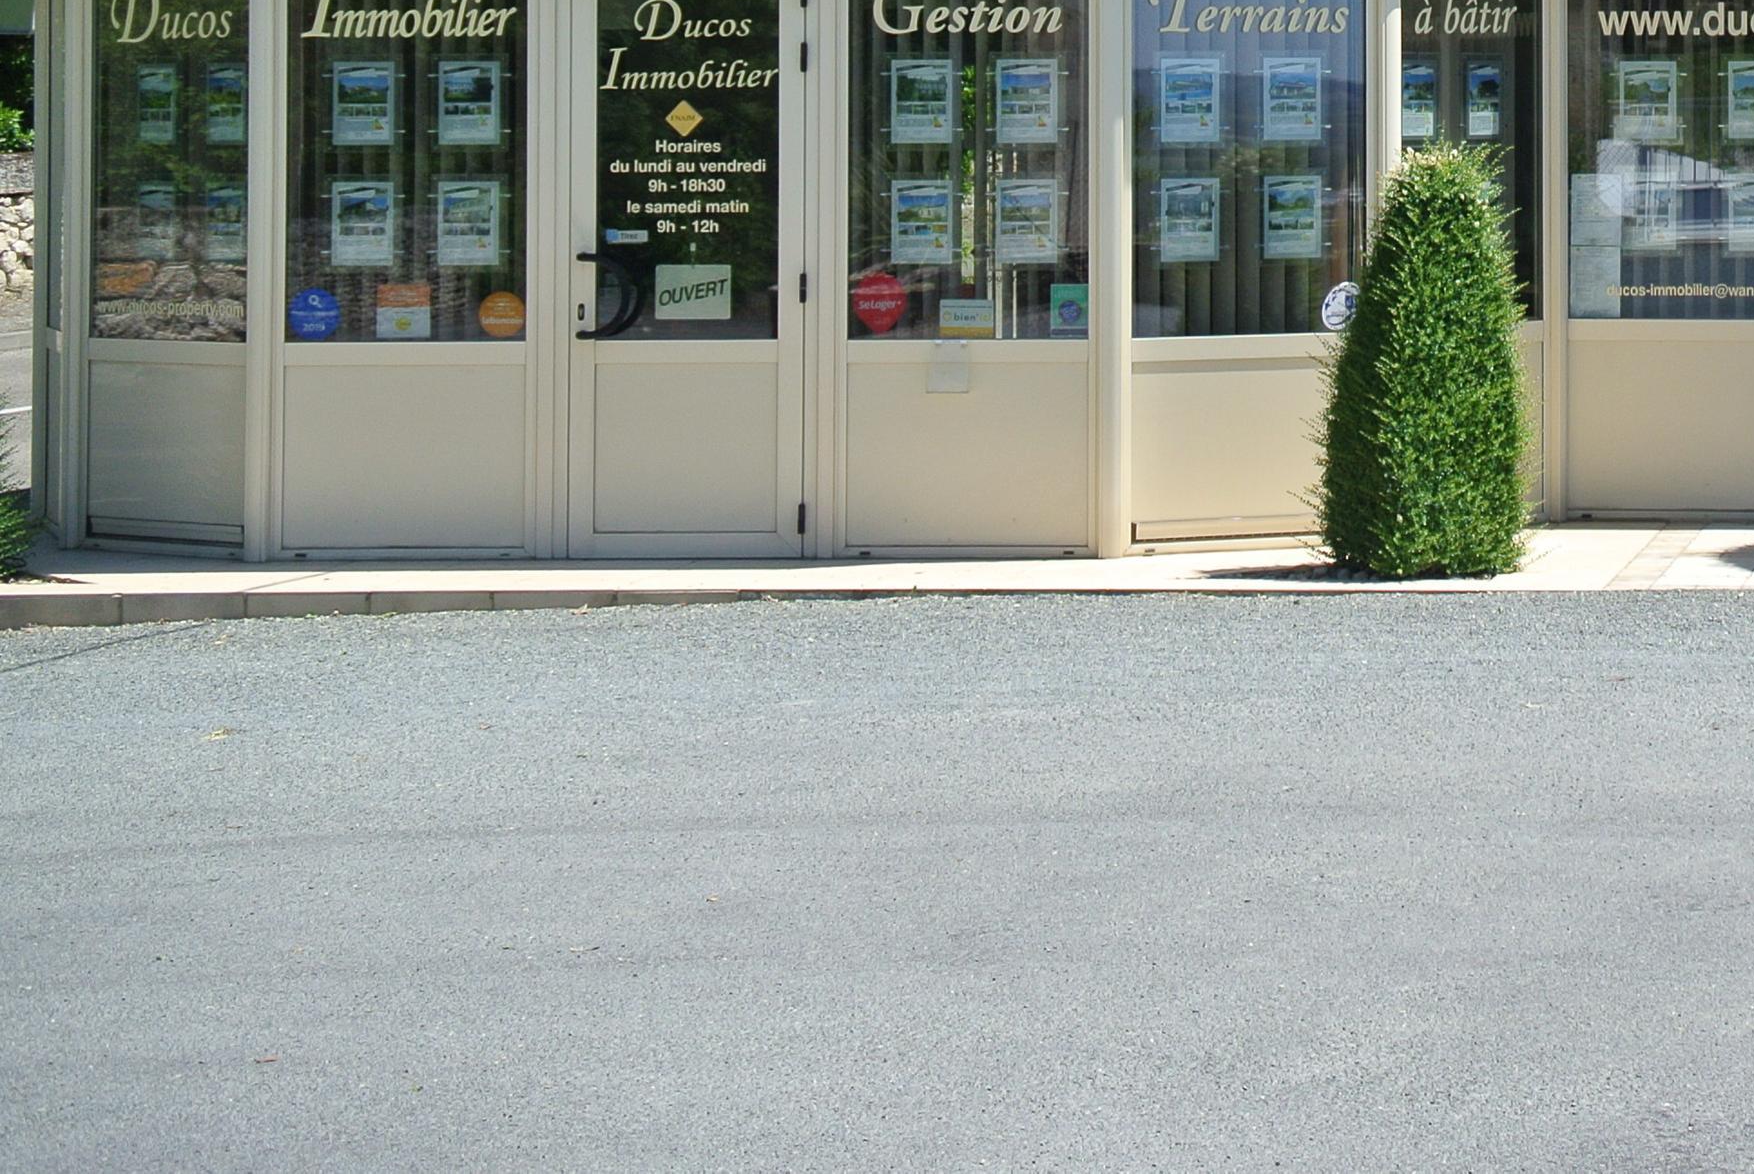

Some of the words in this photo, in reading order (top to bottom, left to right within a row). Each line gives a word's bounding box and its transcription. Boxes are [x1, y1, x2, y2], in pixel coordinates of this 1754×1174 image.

[600, 47, 778, 89] Immobilier
[655, 139, 722, 153] Horaires
[610, 160, 629, 172] du
[634, 160, 671, 172] lundi
[676, 163, 695, 172] au
[700, 159, 767, 172] vendredi
[648, 180, 667, 192] 9h
[681, 179, 726, 192] 18h30
[627, 200, 641, 213] le
[645, 200, 701, 213] samedi
[706, 200, 749, 213] matin
[657, 220, 676, 233] 9h
[692, 220, 719, 233] 12h
[659, 279, 728, 307] OUVERT
